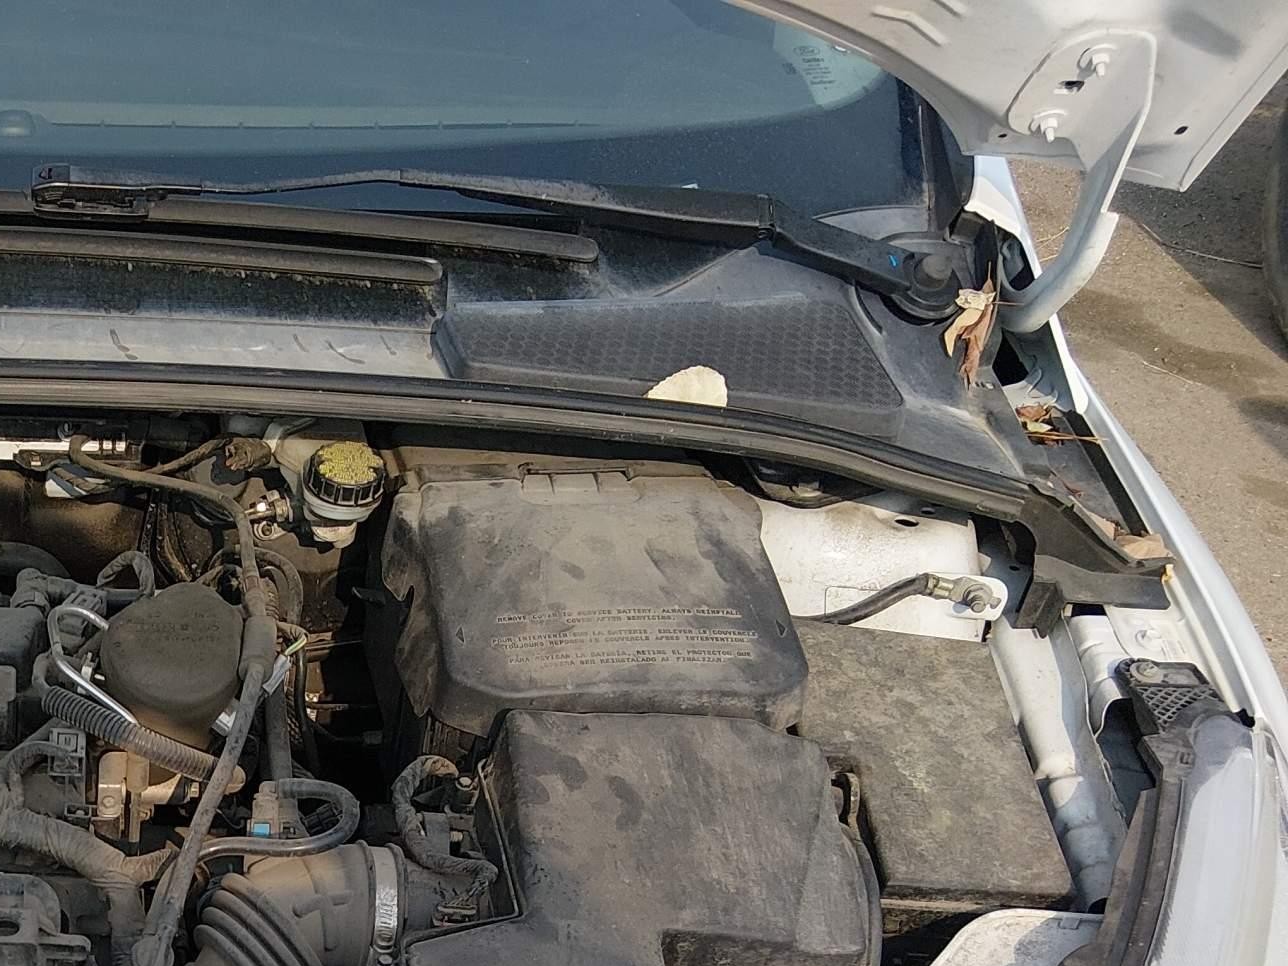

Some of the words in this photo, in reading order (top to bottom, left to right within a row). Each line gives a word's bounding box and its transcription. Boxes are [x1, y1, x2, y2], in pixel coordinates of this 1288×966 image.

[498, 614, 527, 623] REMOVE
[696, 608, 741, 617] REINSTALL
[712, 629, 757, 637] COUVERCLE
